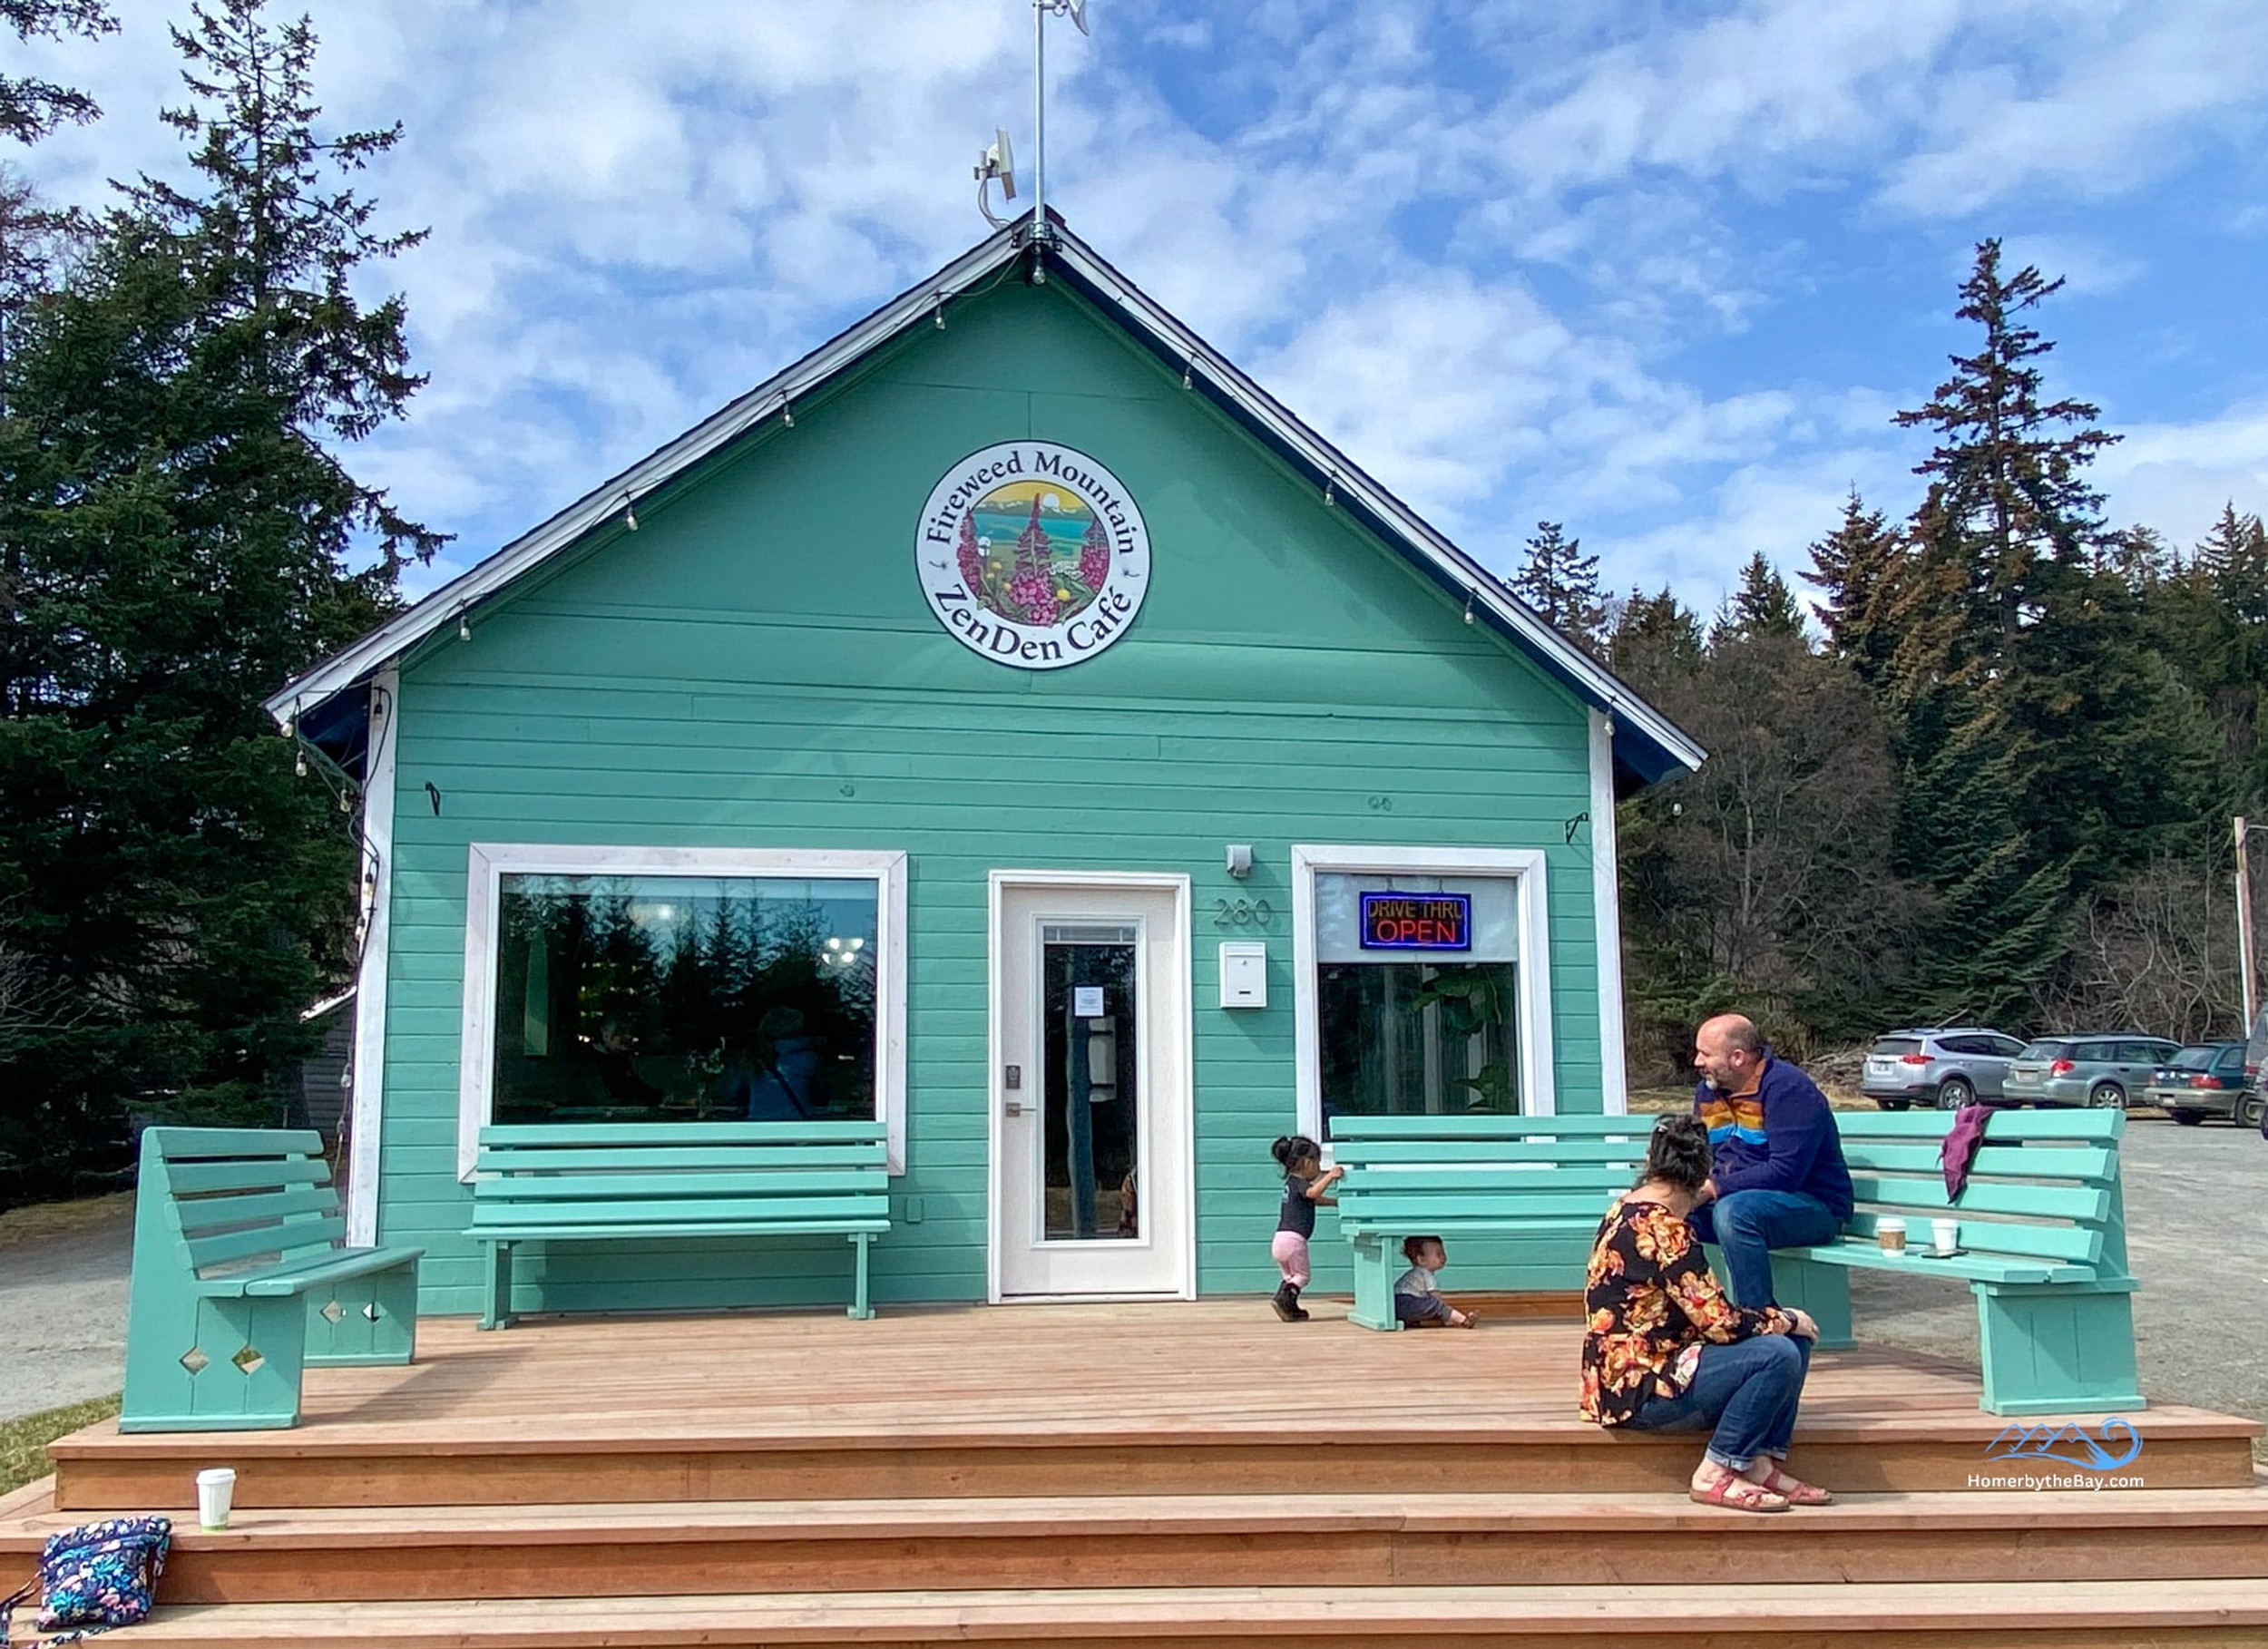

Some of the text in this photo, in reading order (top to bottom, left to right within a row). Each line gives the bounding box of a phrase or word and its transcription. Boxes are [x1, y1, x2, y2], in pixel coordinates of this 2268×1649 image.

[926, 451, 1138, 556] Fireweed Mountain
[935, 583, 1132, 661] ZenDen Café
[1367, 900, 1464, 920] DRIVE THRU
[1376, 920, 1456, 942] OPEN
